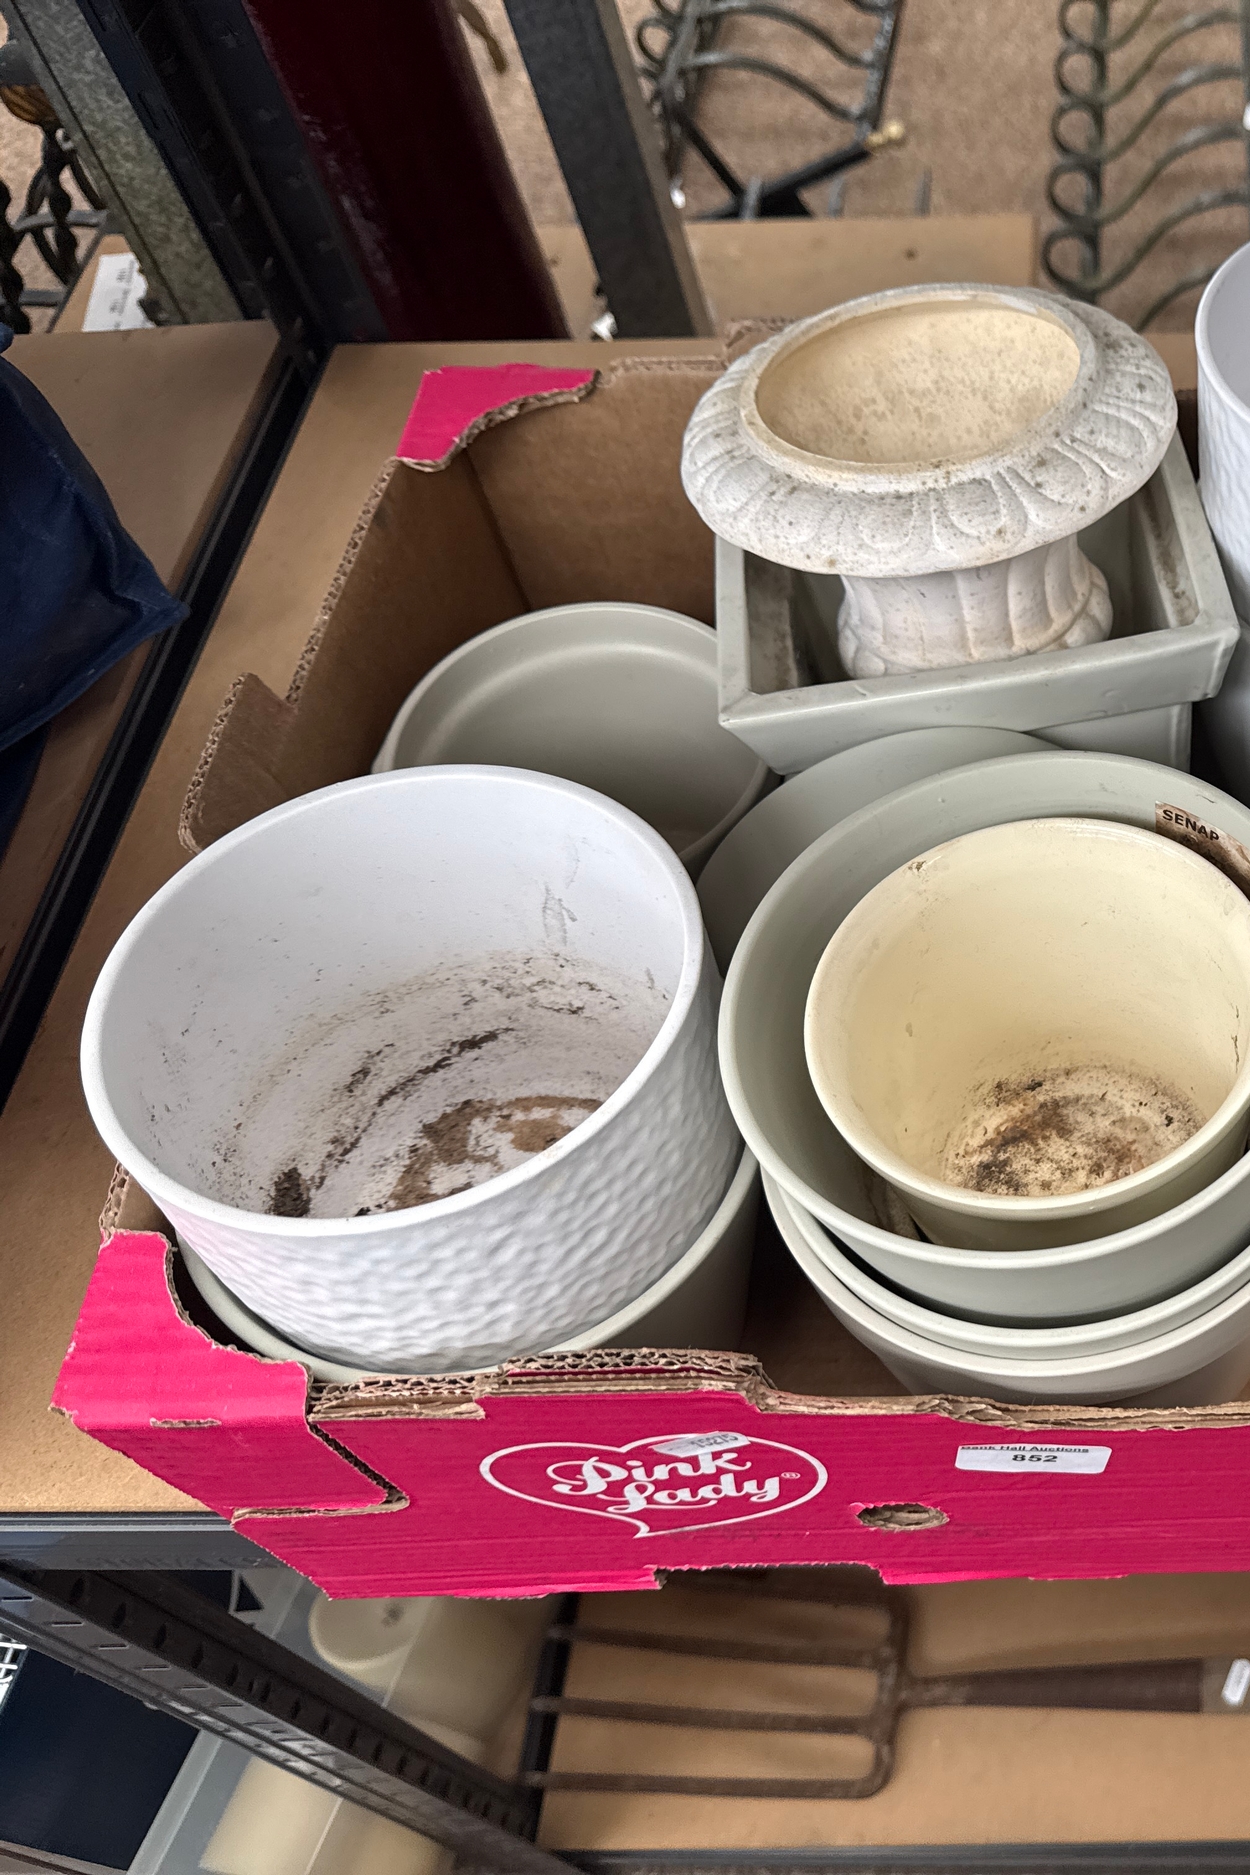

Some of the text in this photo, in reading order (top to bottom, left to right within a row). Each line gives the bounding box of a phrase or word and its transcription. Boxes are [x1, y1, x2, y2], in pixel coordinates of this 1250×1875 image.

[1162, 808, 1220, 841] SENAP
[1012, 1454, 1058, 1463] 852
[1029, 1446, 1090, 1454] Auctions
[546, 1452, 752, 1496] Pink
